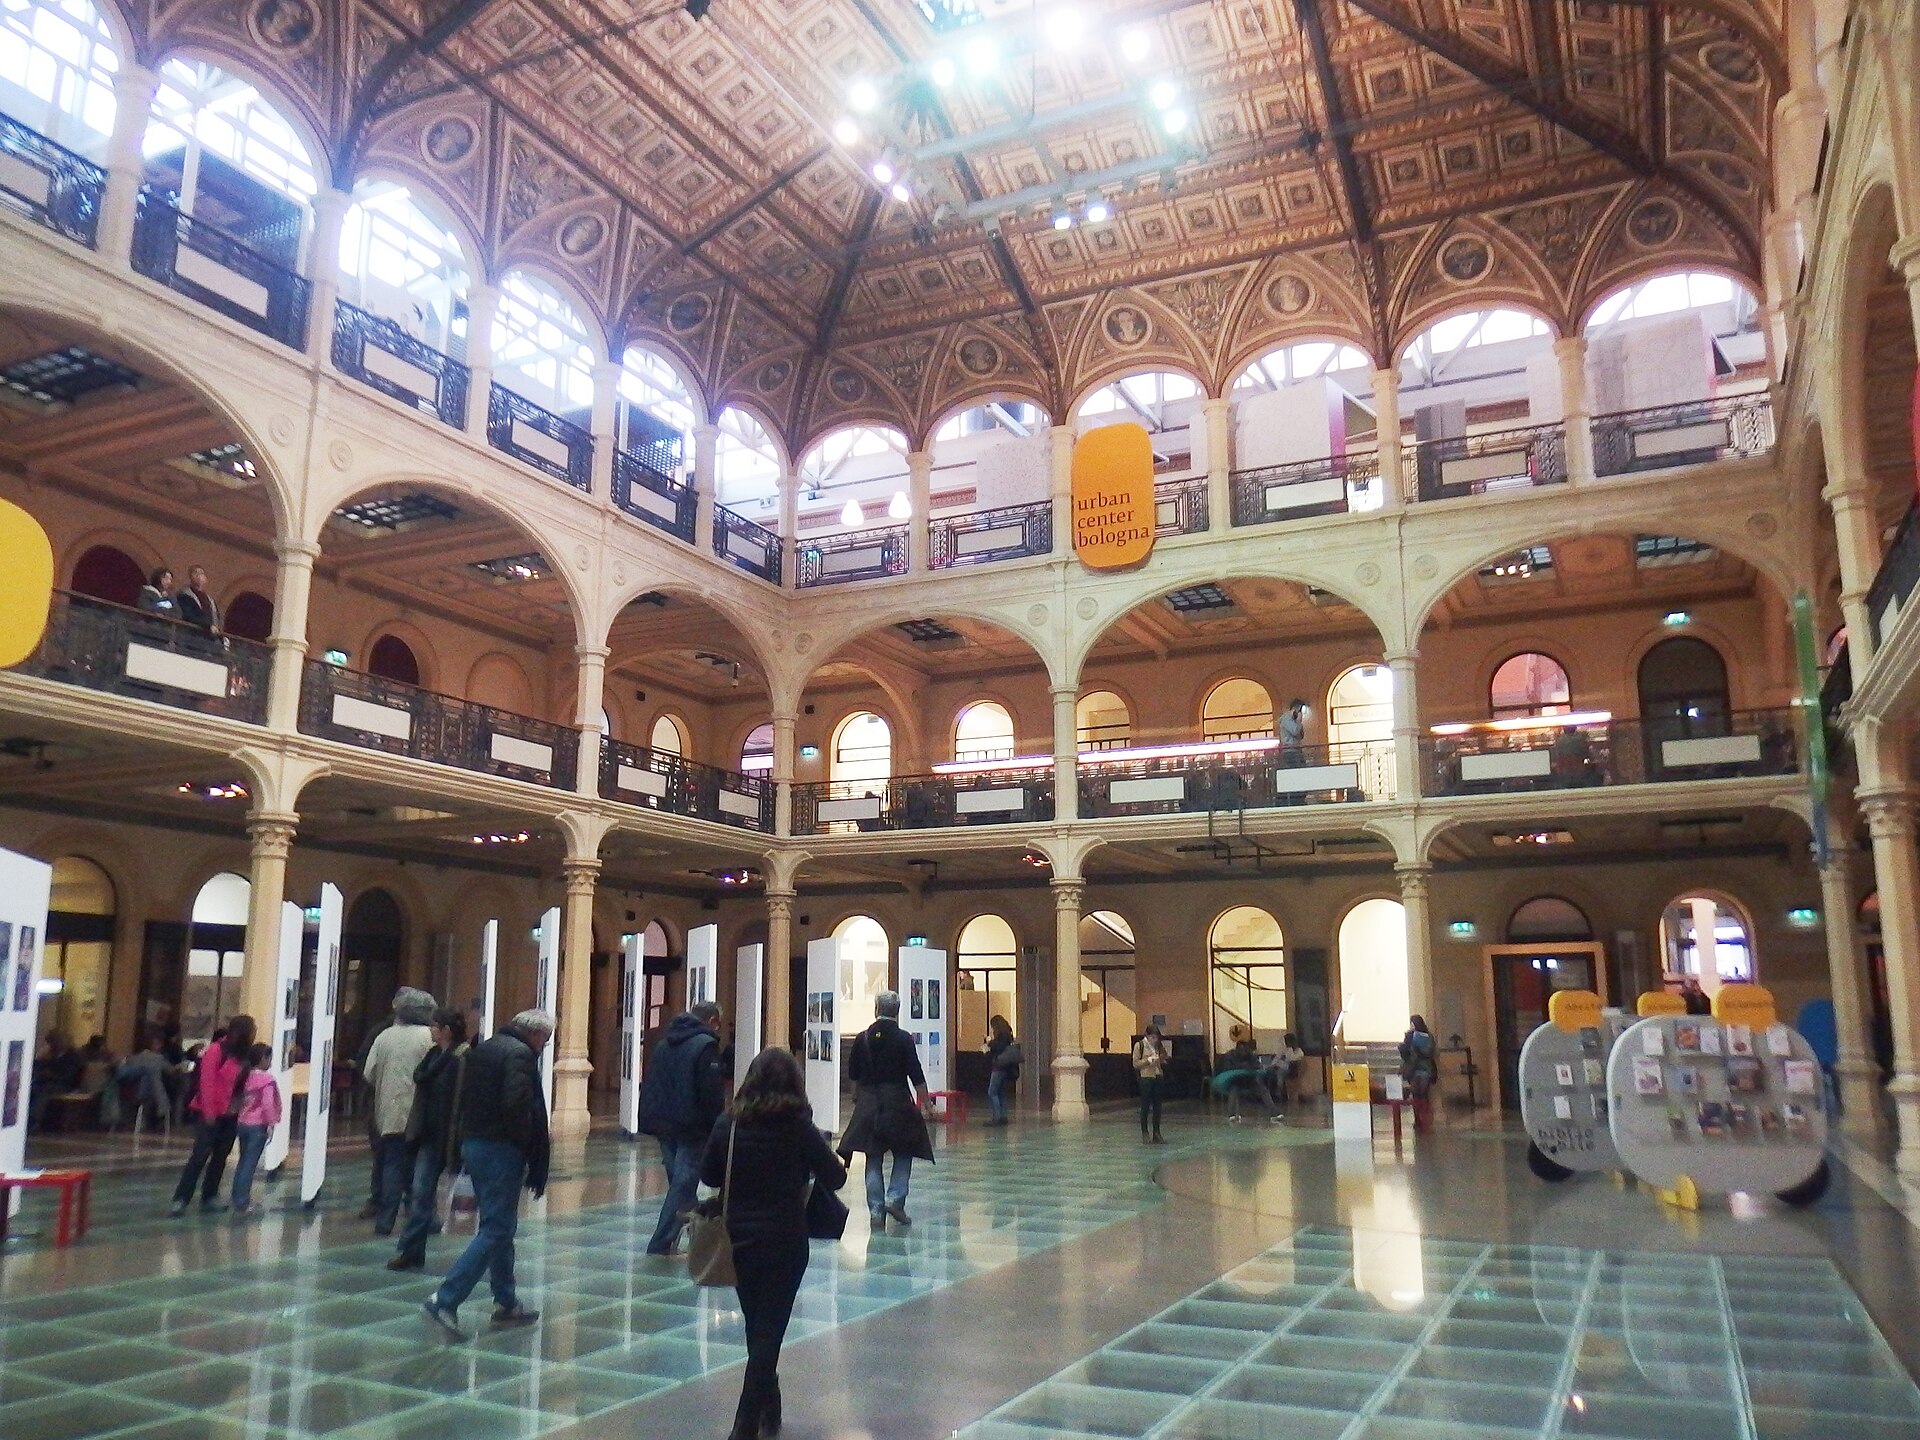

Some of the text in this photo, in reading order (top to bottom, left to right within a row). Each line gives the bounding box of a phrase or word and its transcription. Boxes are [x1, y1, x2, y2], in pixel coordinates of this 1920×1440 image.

[1077, 491, 1131, 511] urban
[1077, 509, 1135, 529] center
[1077, 526, 1150, 548] bologna
